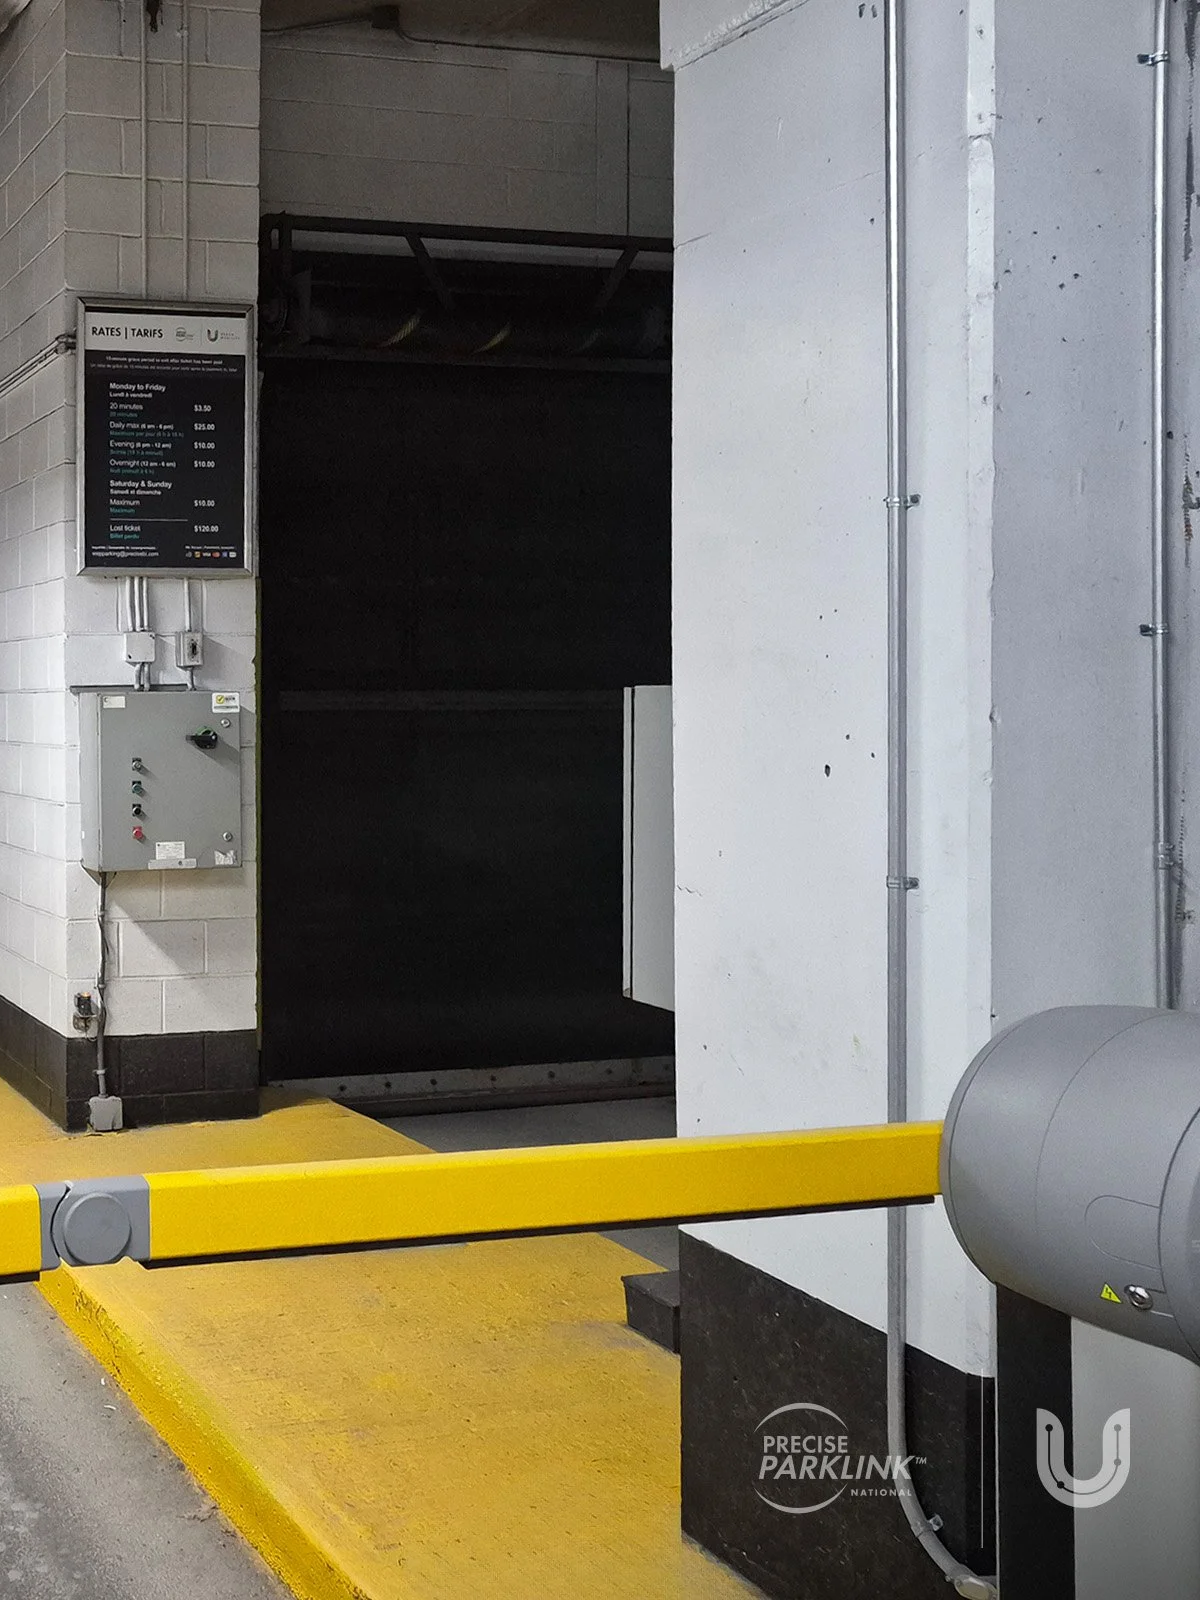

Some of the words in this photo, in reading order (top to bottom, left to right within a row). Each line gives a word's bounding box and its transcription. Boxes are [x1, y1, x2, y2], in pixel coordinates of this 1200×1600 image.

[91, 326, 121, 337] RATES
[130, 328, 163, 338] TARIFS
[109, 382, 136, 391] Monday
[145, 384, 166, 392] Friday
[194, 404, 212, 412] $3.50
[109, 421, 125, 429] Daily
[194, 423, 215, 431] $25.00
[109, 440, 135, 449] Evening
[194, 441, 215, 449] $10.00
[109, 459, 140, 468] Overnight
[194, 460, 215, 468] $10.00
[109, 480, 139, 489] Saturday
[147, 481, 172, 489] Sunday
[194, 499, 215, 507] $10.00
[194, 525, 219, 533] $120.00
